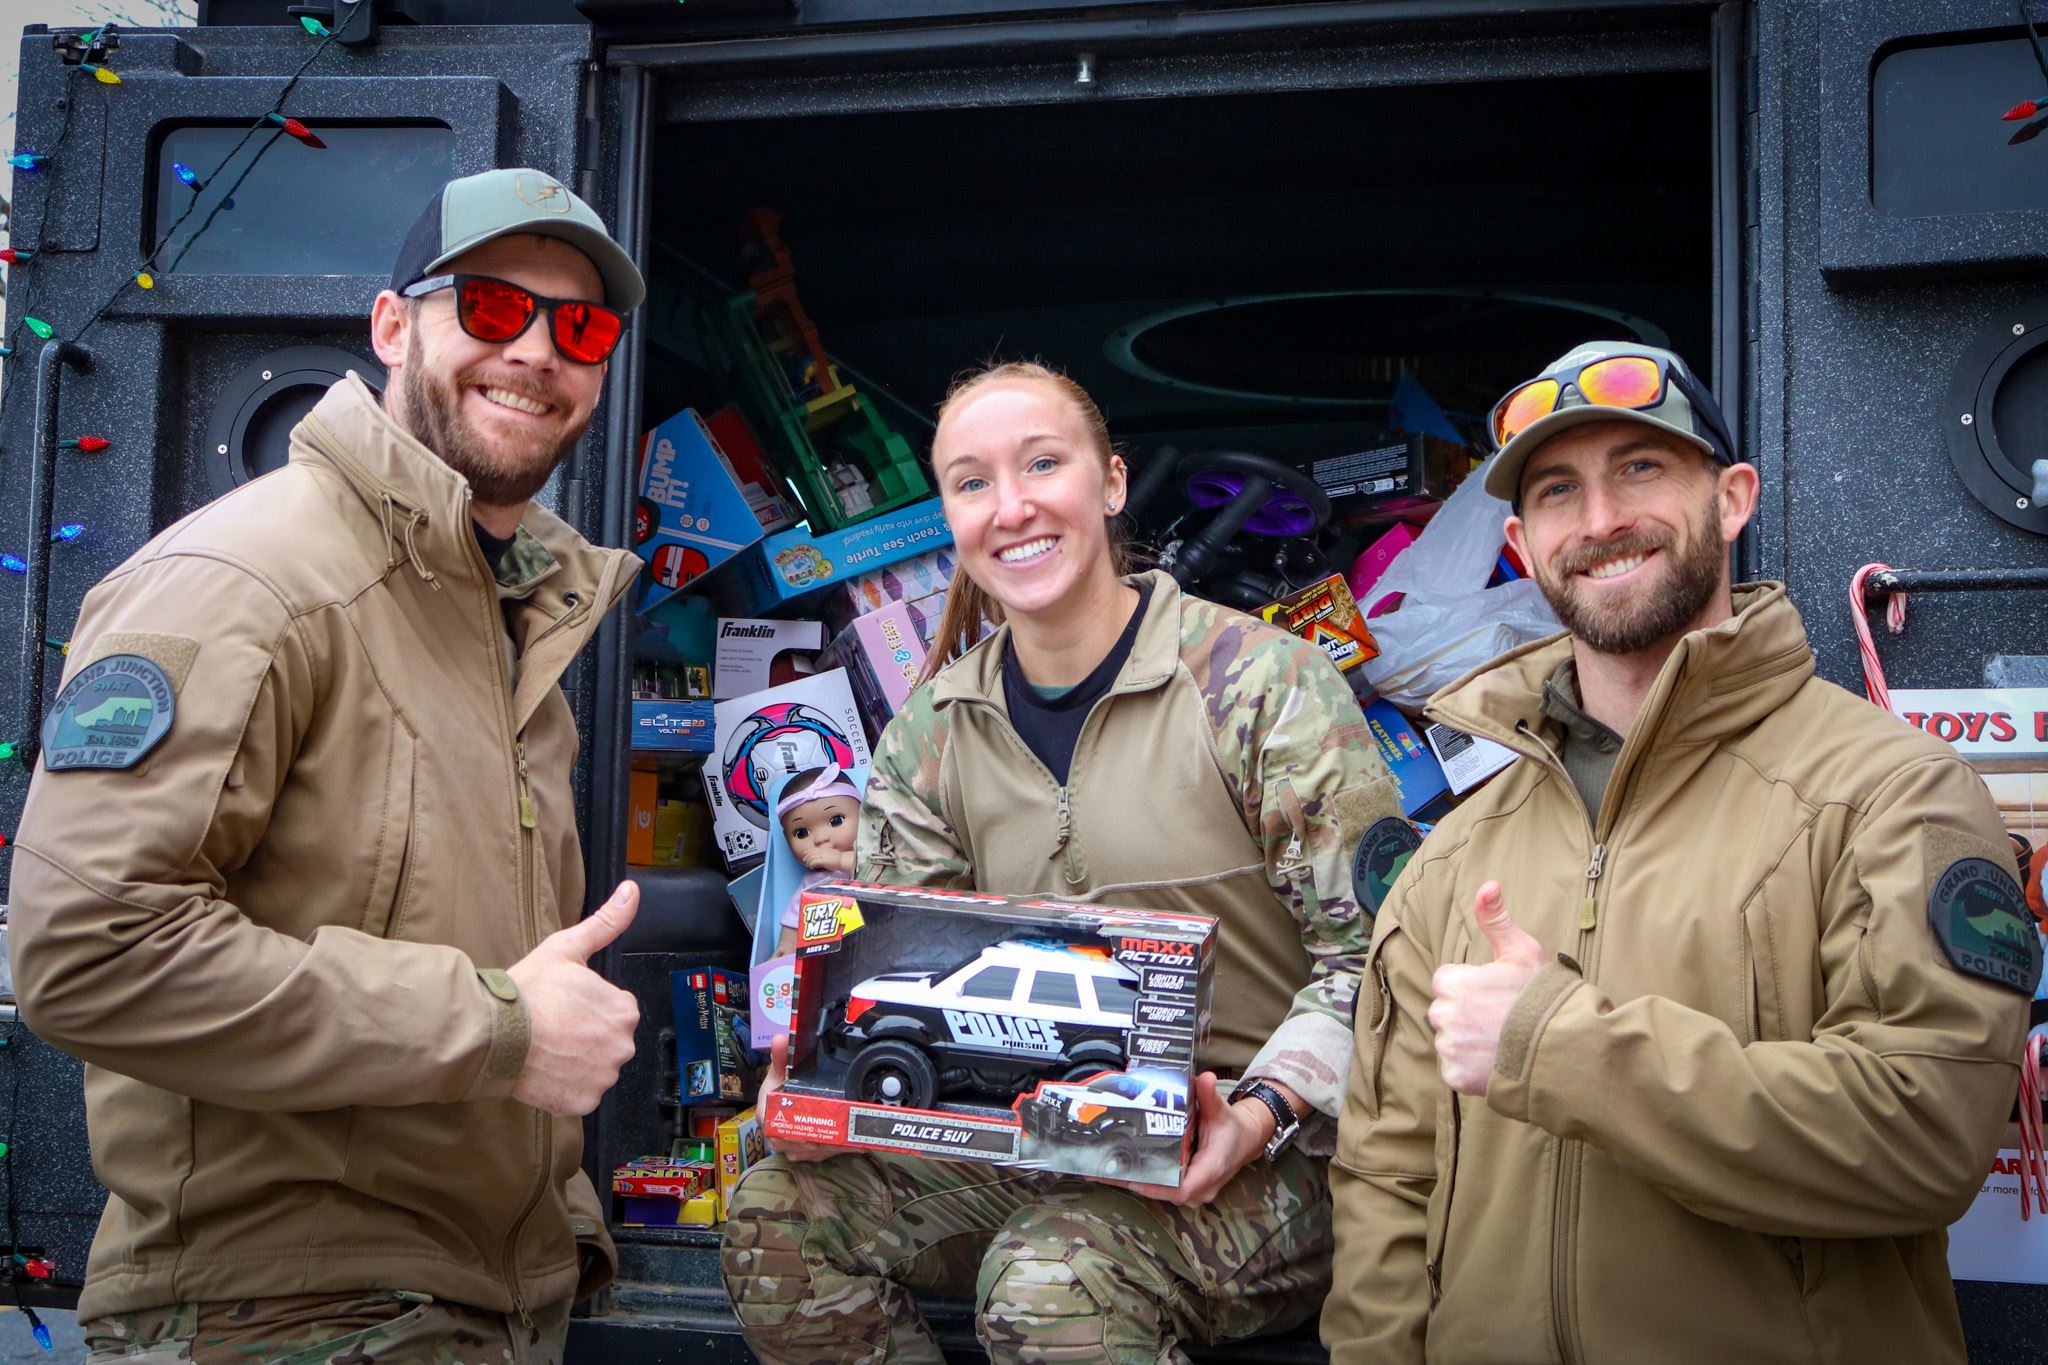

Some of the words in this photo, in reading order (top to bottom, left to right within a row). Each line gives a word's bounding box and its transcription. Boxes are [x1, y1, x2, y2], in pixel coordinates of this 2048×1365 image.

[646, 439, 676, 504] BUMP
[665, 478, 689, 508] IT!
[873, 520, 896, 536] early
[896, 519, 913, 530] into
[913, 514, 931, 525] dive
[841, 527, 874, 547] reading!
[882, 537, 905, 552] Sea
[906, 526, 942, 545] Teach
[845, 546, 881, 566] Turtle
[1291, 597, 1333, 629] DIRT
[720, 621, 776, 639] Franklin
[54, 664, 108, 714] GRAND
[109, 660, 170, 714] JUNCTION
[640, 718, 692, 727] ELITE
[692, 719, 705, 727] 2.0
[844, 707, 864, 753] SOCCER
[1902, 711, 2018, 743] TOYS
[1370, 719, 1403, 761] FEATURES:
[51, 750, 129, 766] POLICE
[706, 775, 723, 807] Franklin
[1357, 832, 1379, 881] GRAND
[1939, 865, 1979, 904] GRAND
[805, 901, 839, 921] TRY
[805, 918, 837, 938] ME!
[806, 945, 822, 954] AGES
[1121, 937, 1195, 956] MAXX
[1118, 950, 1195, 967] ACTION
[1148, 973, 1178, 982] LIGHTS
[1960, 952, 2030, 986] POLICE
[715, 983, 726, 994] LEGO
[1147, 980, 1184, 990] SOUNDS!
[1140, 1005, 1186, 1017] MOTORIZED
[1147, 1013, 1177, 1022] DRIVE!
[941, 1009, 1060, 1043] POLICE
[1002, 1040, 1050, 1051] PURSUIT
[1136, 1038, 1170, 1049] RUBBER
[1139, 1045, 1166, 1054] TIRES!
[793, 1115, 837, 1127] WARNING:
[794, 1124, 815, 1133] HAZARD
[1145, 1111, 1187, 1134] POLICE
[891, 1123, 939, 1141] POLICE
[942, 1129, 973, 1144] SUV
[1993, 1186, 2019, 1195] more
